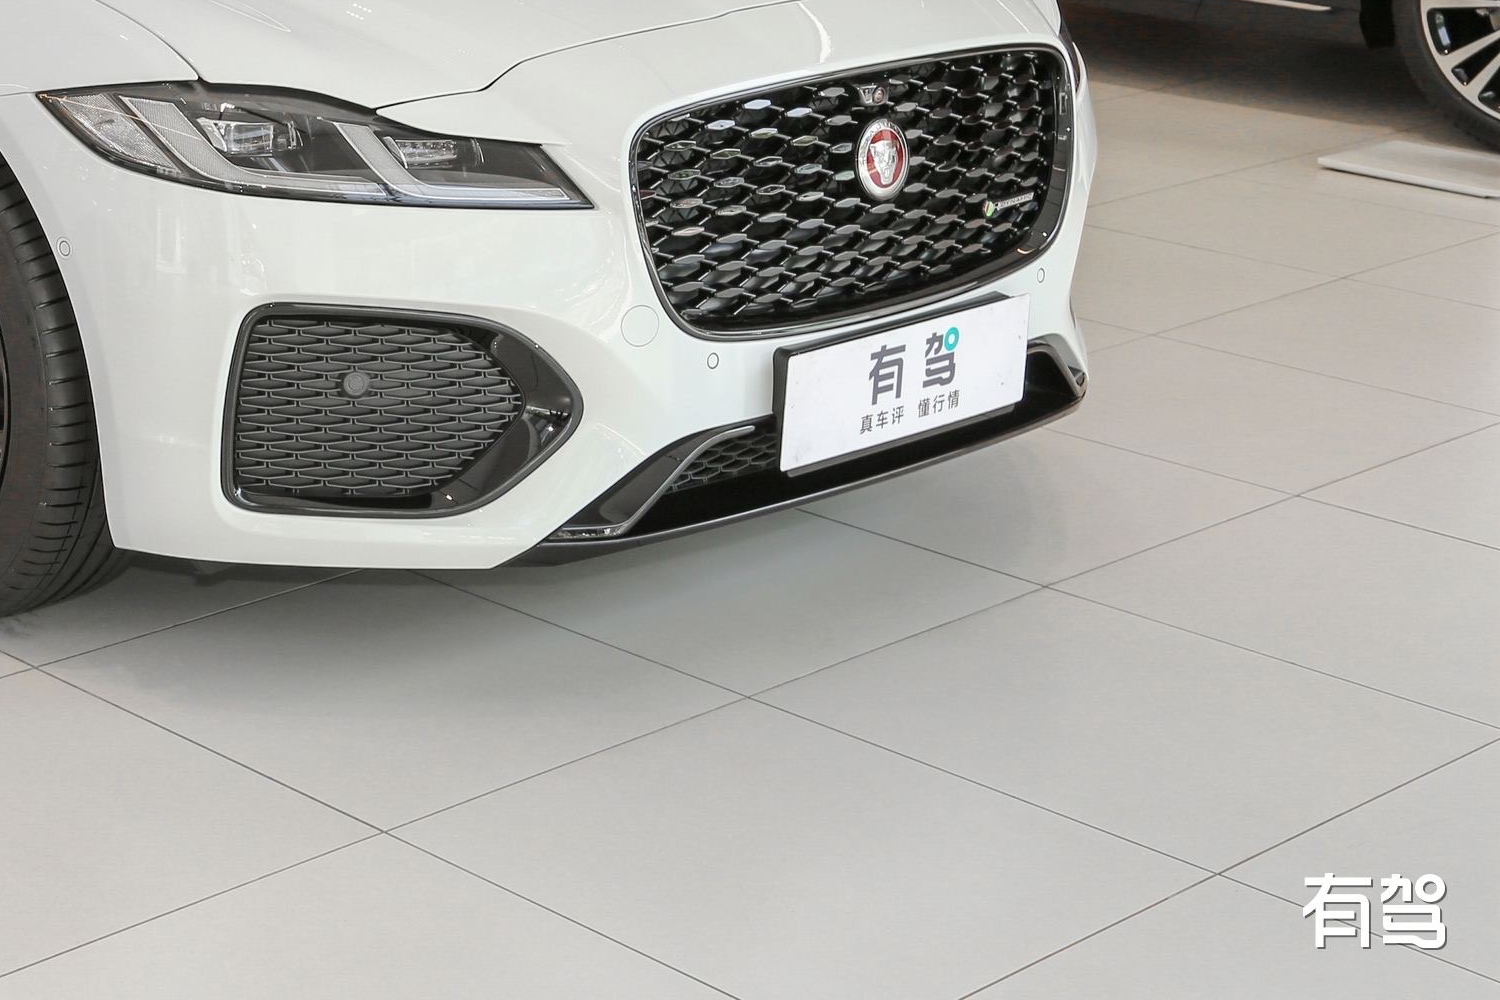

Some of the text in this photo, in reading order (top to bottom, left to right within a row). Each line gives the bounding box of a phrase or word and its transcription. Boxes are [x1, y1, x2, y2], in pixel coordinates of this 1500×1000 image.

[868, 326, 960, 405] 有驾
[859, 389, 961, 435] 真车评 懂行情
